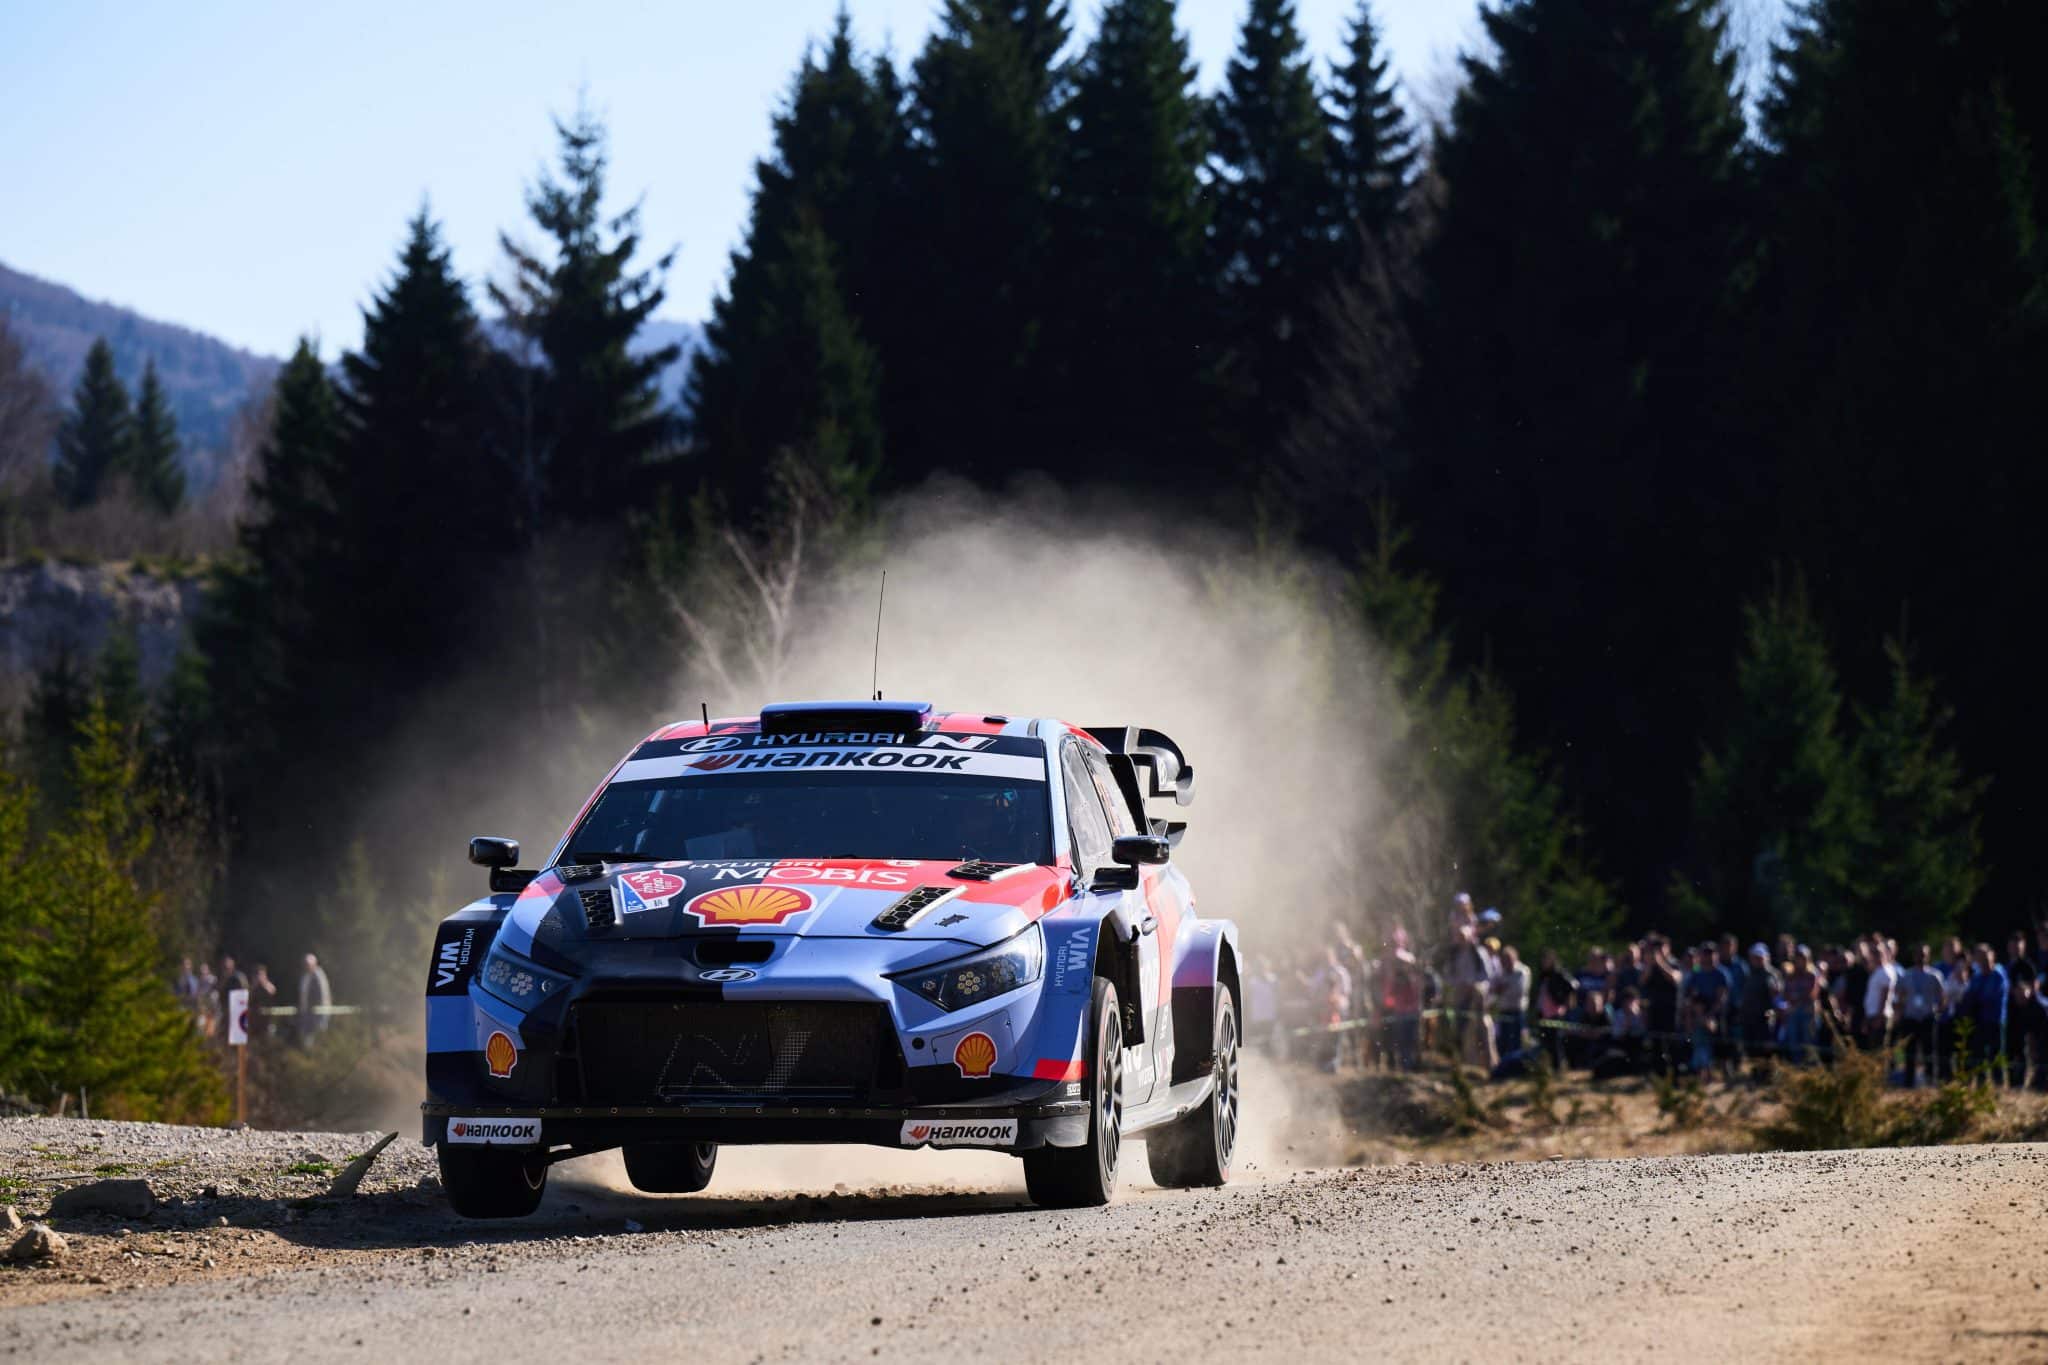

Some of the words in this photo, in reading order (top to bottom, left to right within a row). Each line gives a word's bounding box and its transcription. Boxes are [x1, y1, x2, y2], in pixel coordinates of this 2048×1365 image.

[688, 861, 824, 870] HYUNDAI
[711, 867, 907, 885] MOBIS
[459, 928, 475, 965] HYUNDAI
[1054, 945, 1067, 987] HYUNDAI
